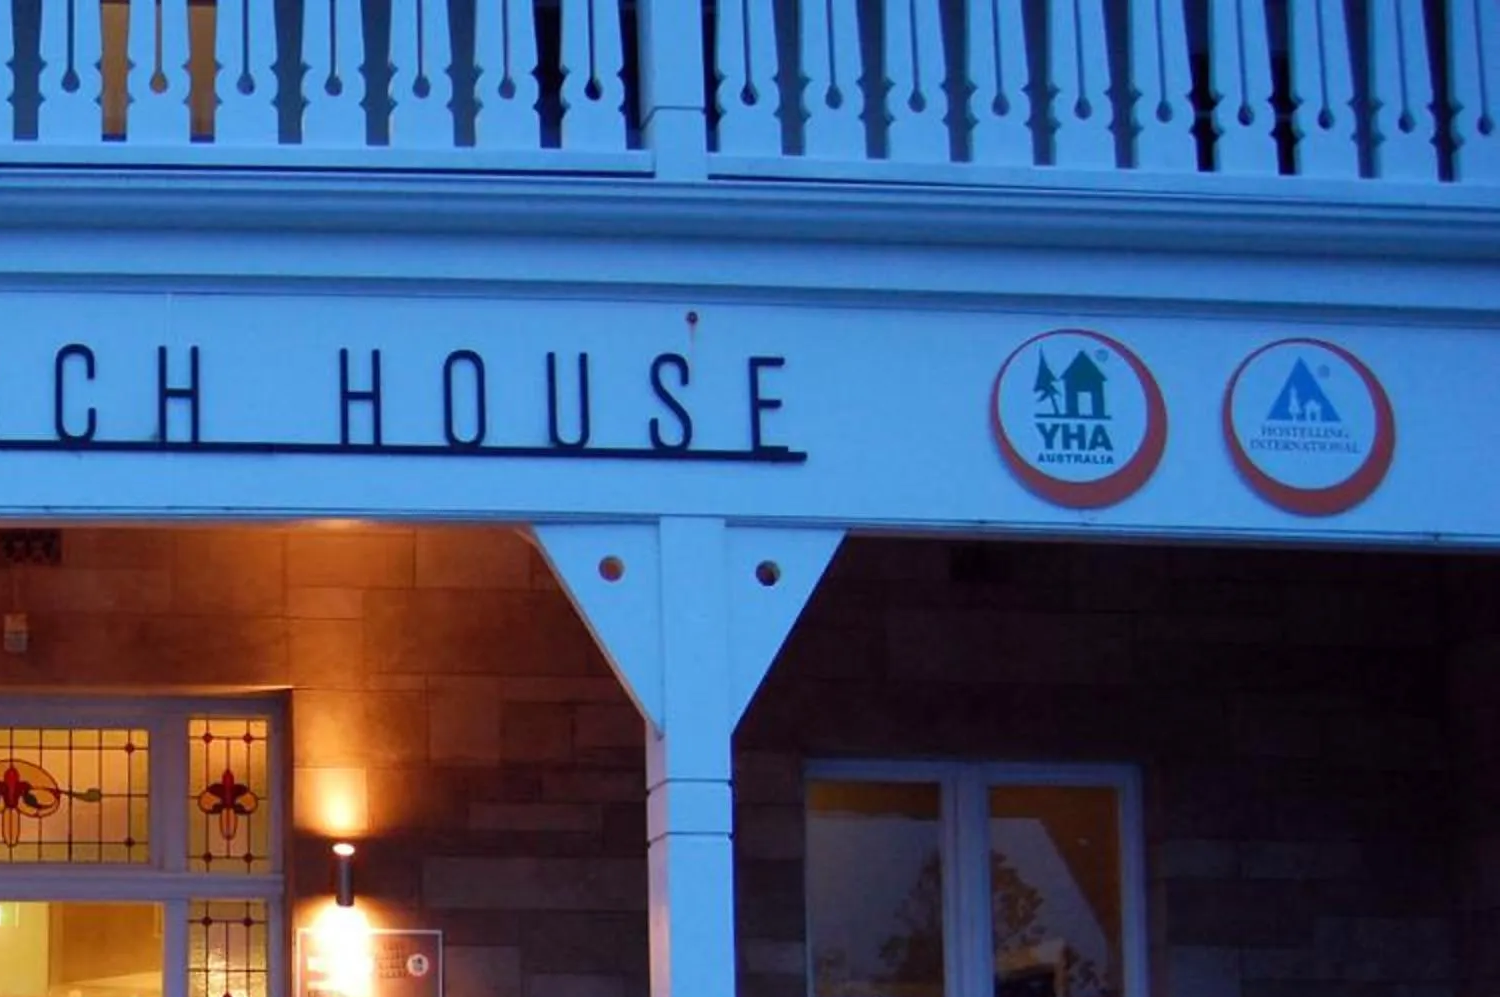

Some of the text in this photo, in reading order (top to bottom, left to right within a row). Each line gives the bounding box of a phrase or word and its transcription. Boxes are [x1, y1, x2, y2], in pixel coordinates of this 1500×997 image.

[339, 348, 789, 453] HOUSE
[1035, 422, 1114, 451] YHA
[1037, 453, 1114, 465] AUSTRALIA
